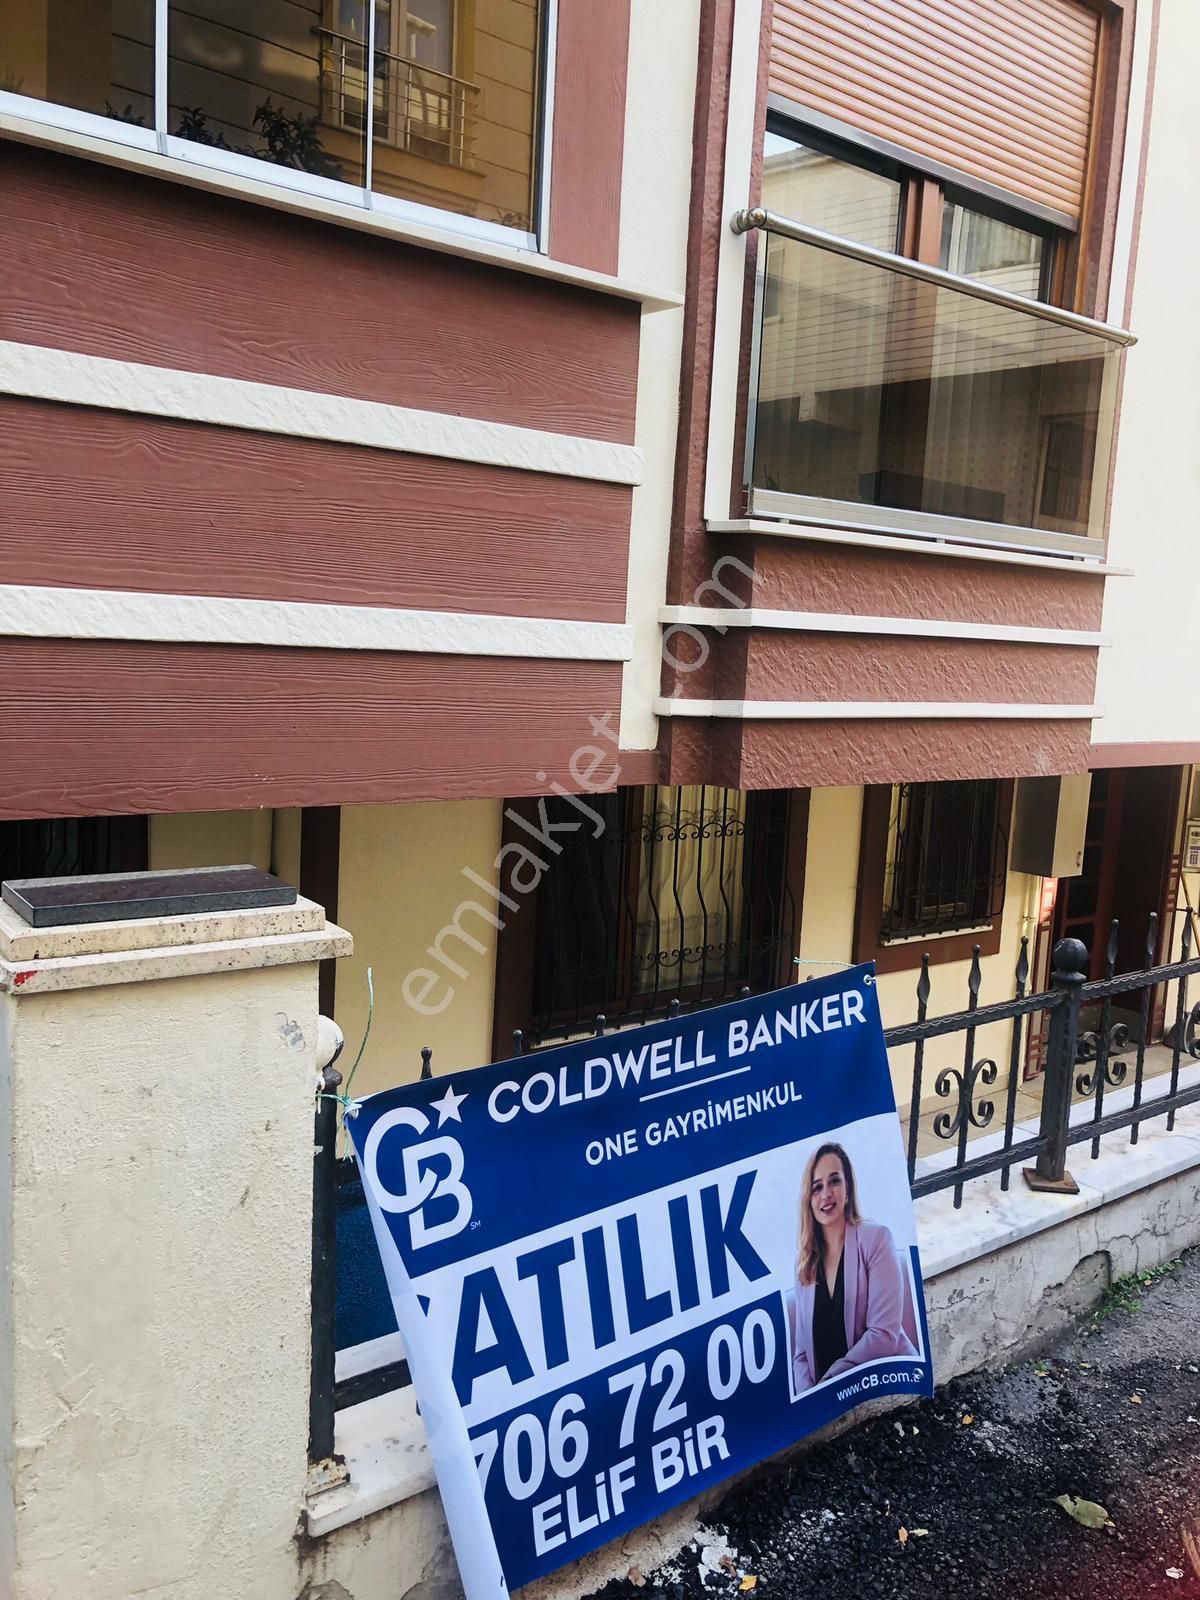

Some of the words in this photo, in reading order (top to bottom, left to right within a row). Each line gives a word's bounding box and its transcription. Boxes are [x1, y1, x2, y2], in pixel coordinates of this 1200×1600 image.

[488, 1030, 716, 1123] COLDWELL
[728, 989, 867, 1059] BANKER
[585, 1128, 639, 1166] ONE
[645, 1081, 802, 1146] GAYRİMENKUL
[363, 1106, 473, 1251] CB
[416, 1169, 772, 1408] ATILIK
[608, 1348, 688, 1450] 72
[707, 1308, 776, 1401] 00
